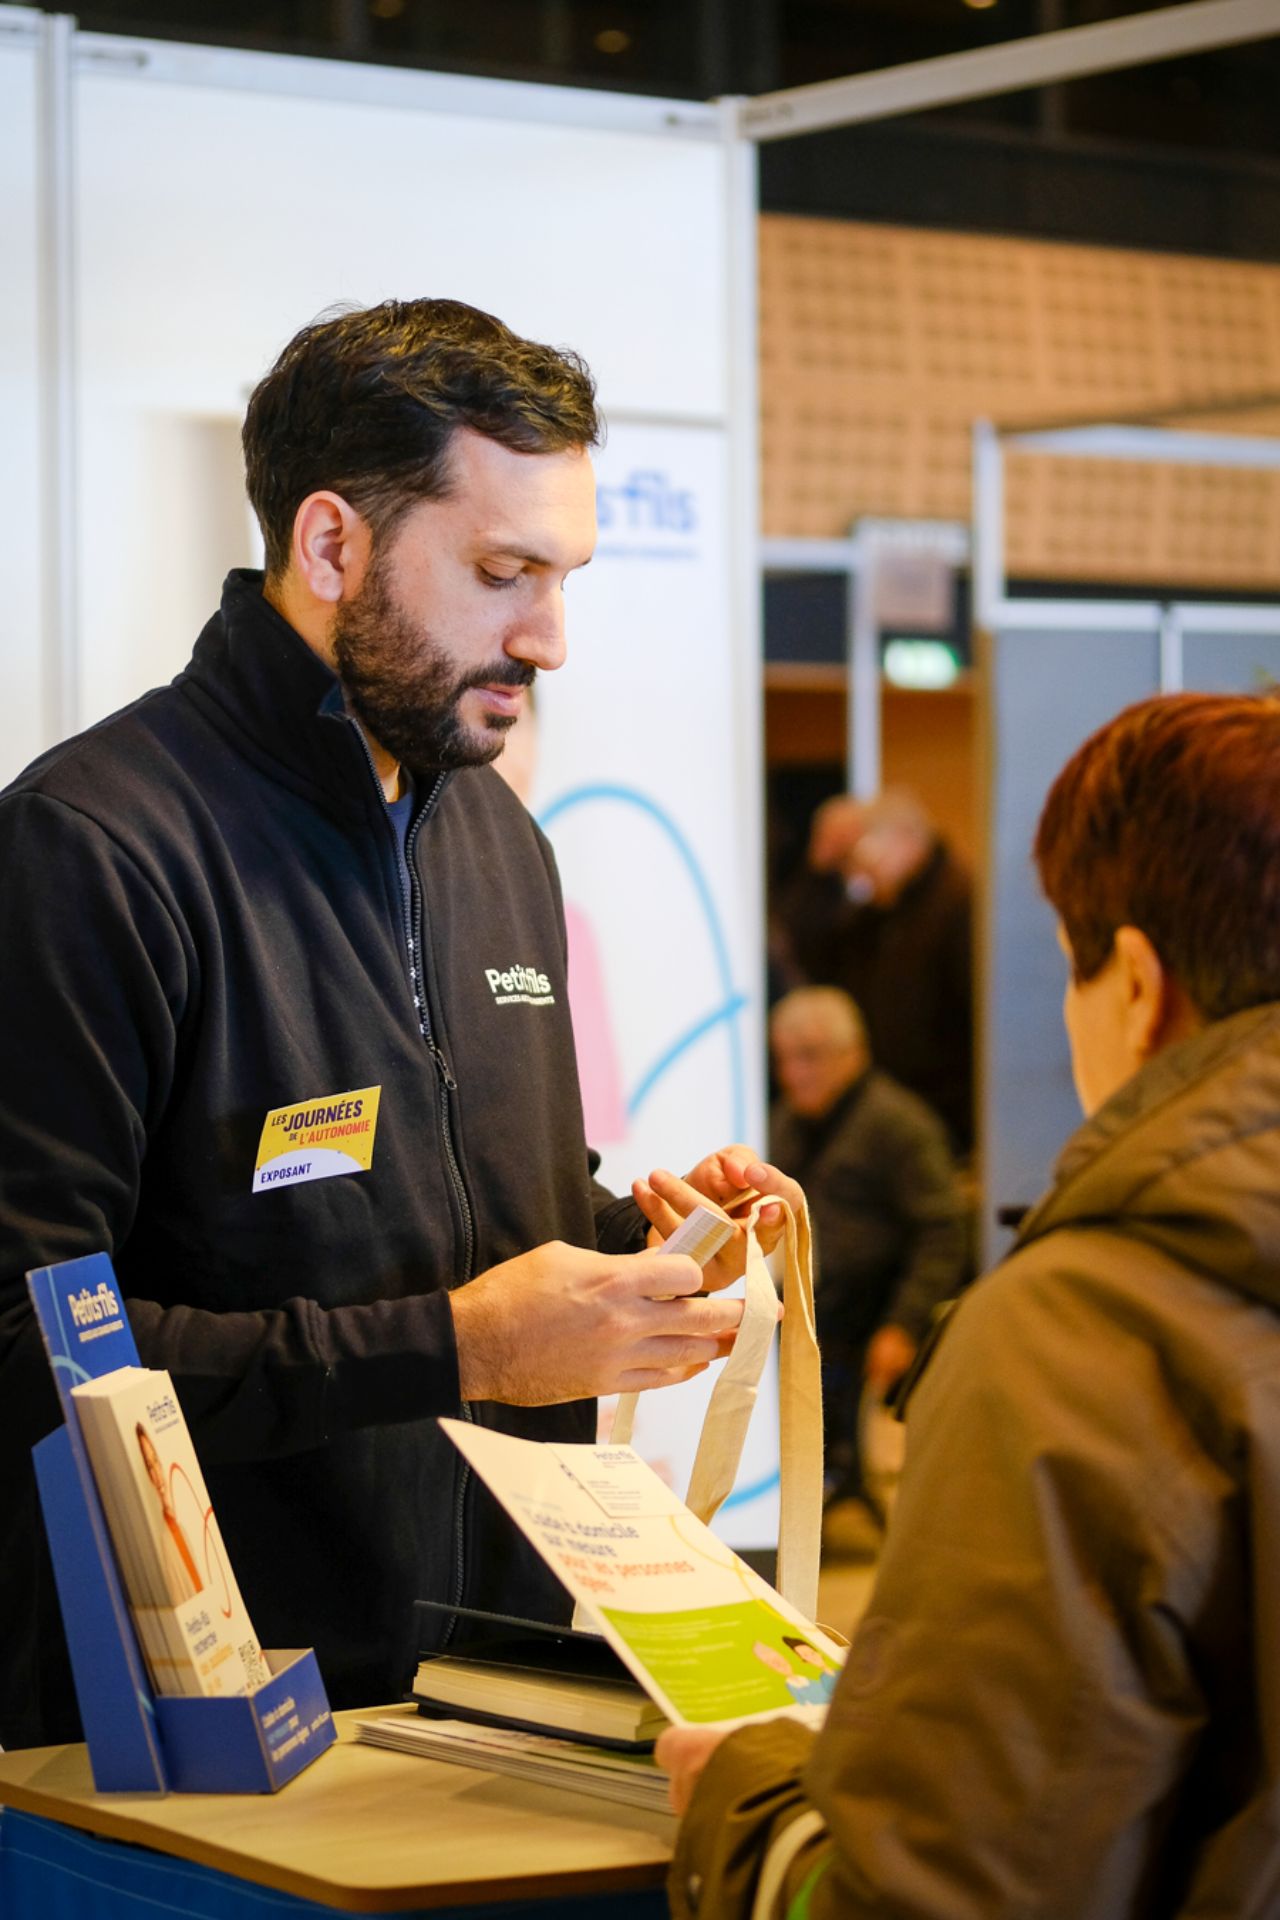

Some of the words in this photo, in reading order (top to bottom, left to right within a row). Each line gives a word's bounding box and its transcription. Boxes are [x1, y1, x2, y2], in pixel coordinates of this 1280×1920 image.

[271, 1114, 288, 1127] LES
[283, 1100, 364, 1132] JOURNÉES
[288, 1132, 299, 1142] DE
[299, 1119, 371, 1146] L'AUTONOMIE
[260, 1162, 313, 1184] EXPOSANT
